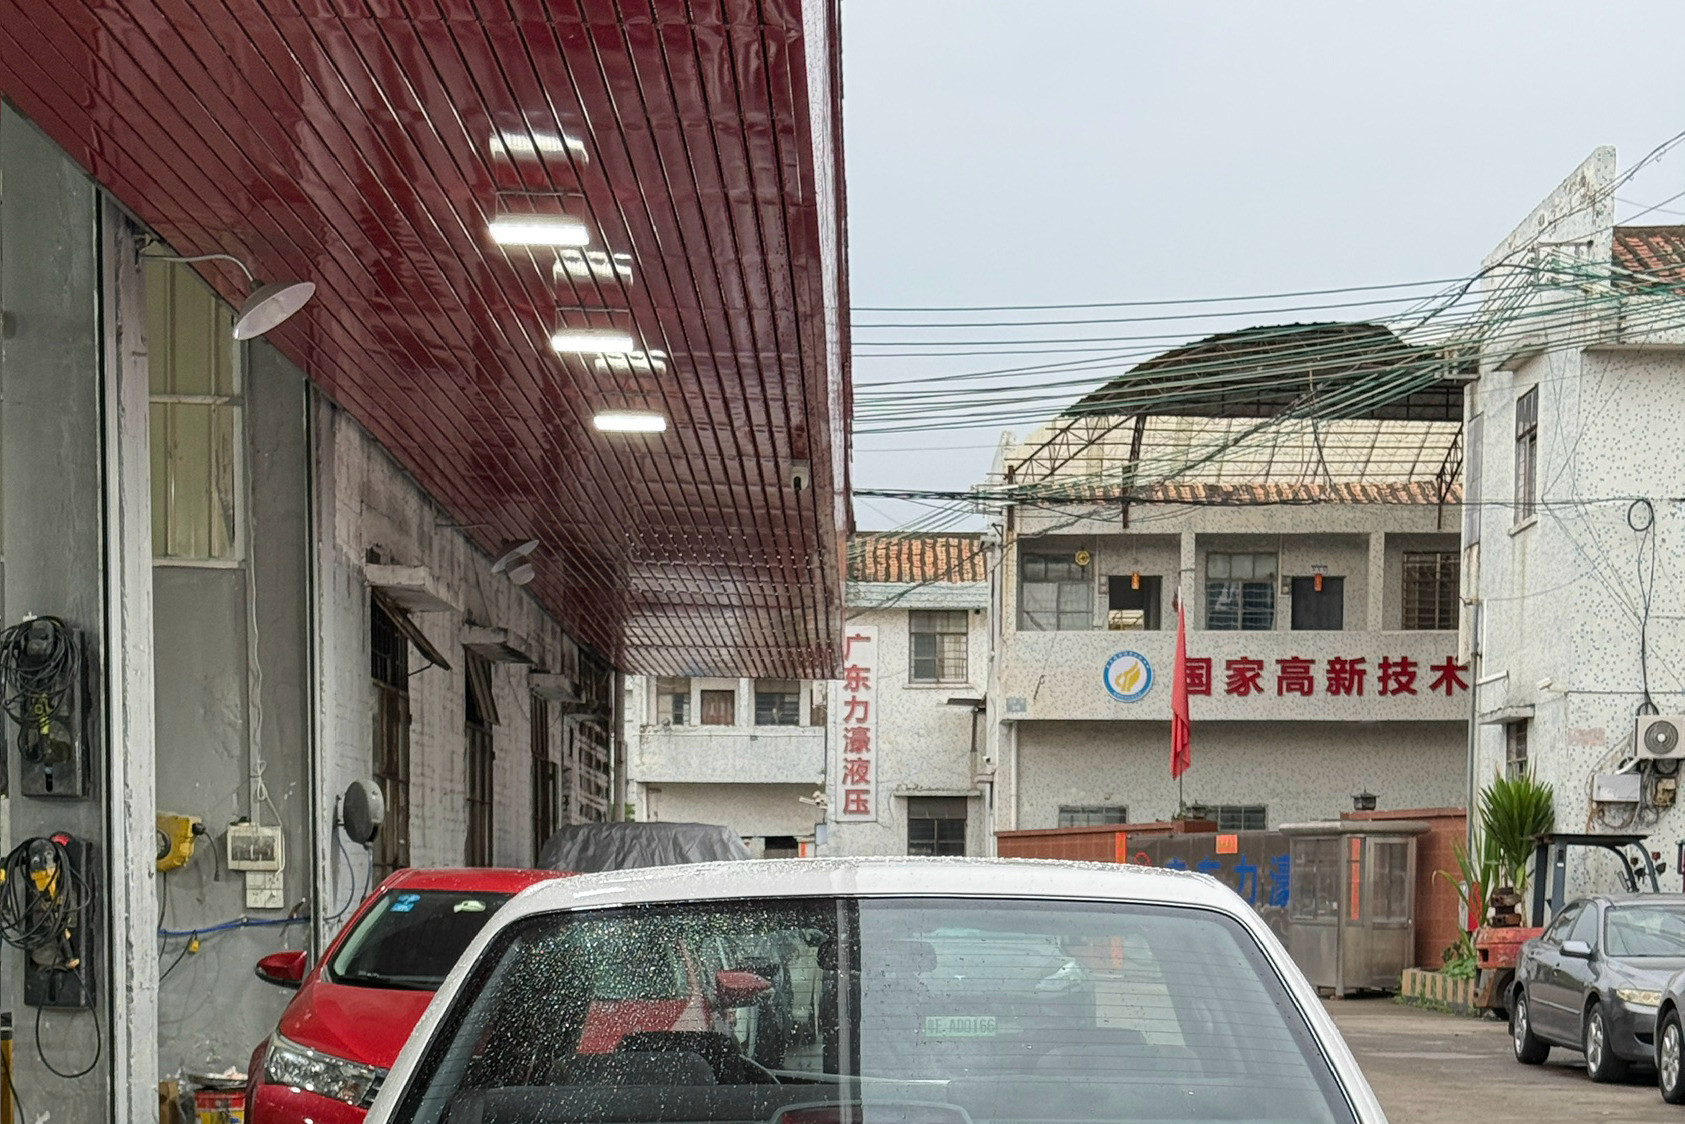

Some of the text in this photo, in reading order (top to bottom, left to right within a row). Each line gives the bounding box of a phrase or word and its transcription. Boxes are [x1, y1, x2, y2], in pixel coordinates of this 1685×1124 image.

[842, 633, 872, 816] 广东力濠液压
[1186, 655, 1469, 697] 国家高新技术
